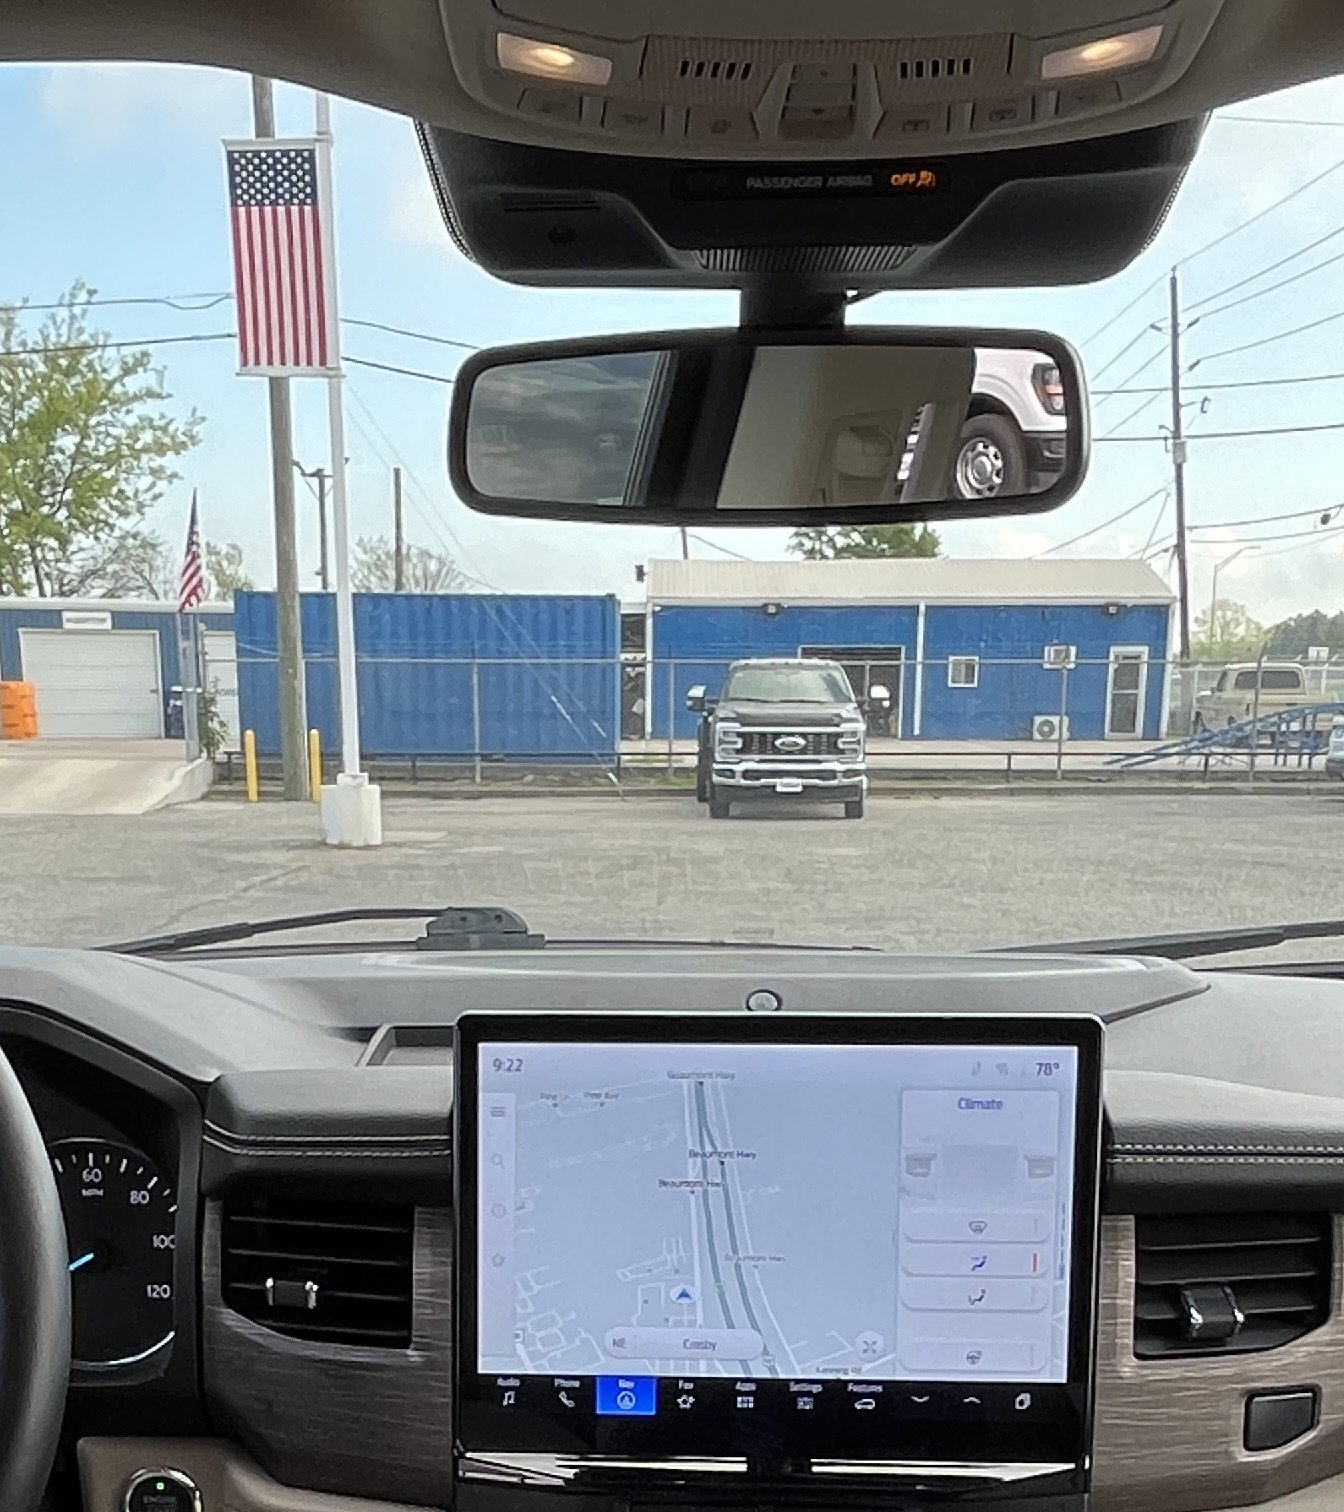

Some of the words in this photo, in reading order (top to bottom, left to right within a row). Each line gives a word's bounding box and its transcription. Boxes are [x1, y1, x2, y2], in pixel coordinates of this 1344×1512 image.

[746, 176, 823, 189] PASSENGER
[890, 173, 916, 186] OFF
[492, 1058, 524, 1072] 9:22
[1035, 1062, 1060, 1076] 78°
[958, 1097, 1004, 1110] Climate
[82, 1168, 102, 1182] 60
[130, 1190, 150, 1204] 80
[146, 1284, 171, 1299] 120
[683, 1338, 717, 1351] Crosby
[497, 1377, 521, 1387] Audio
[554, 1378, 580, 1388] Phone
